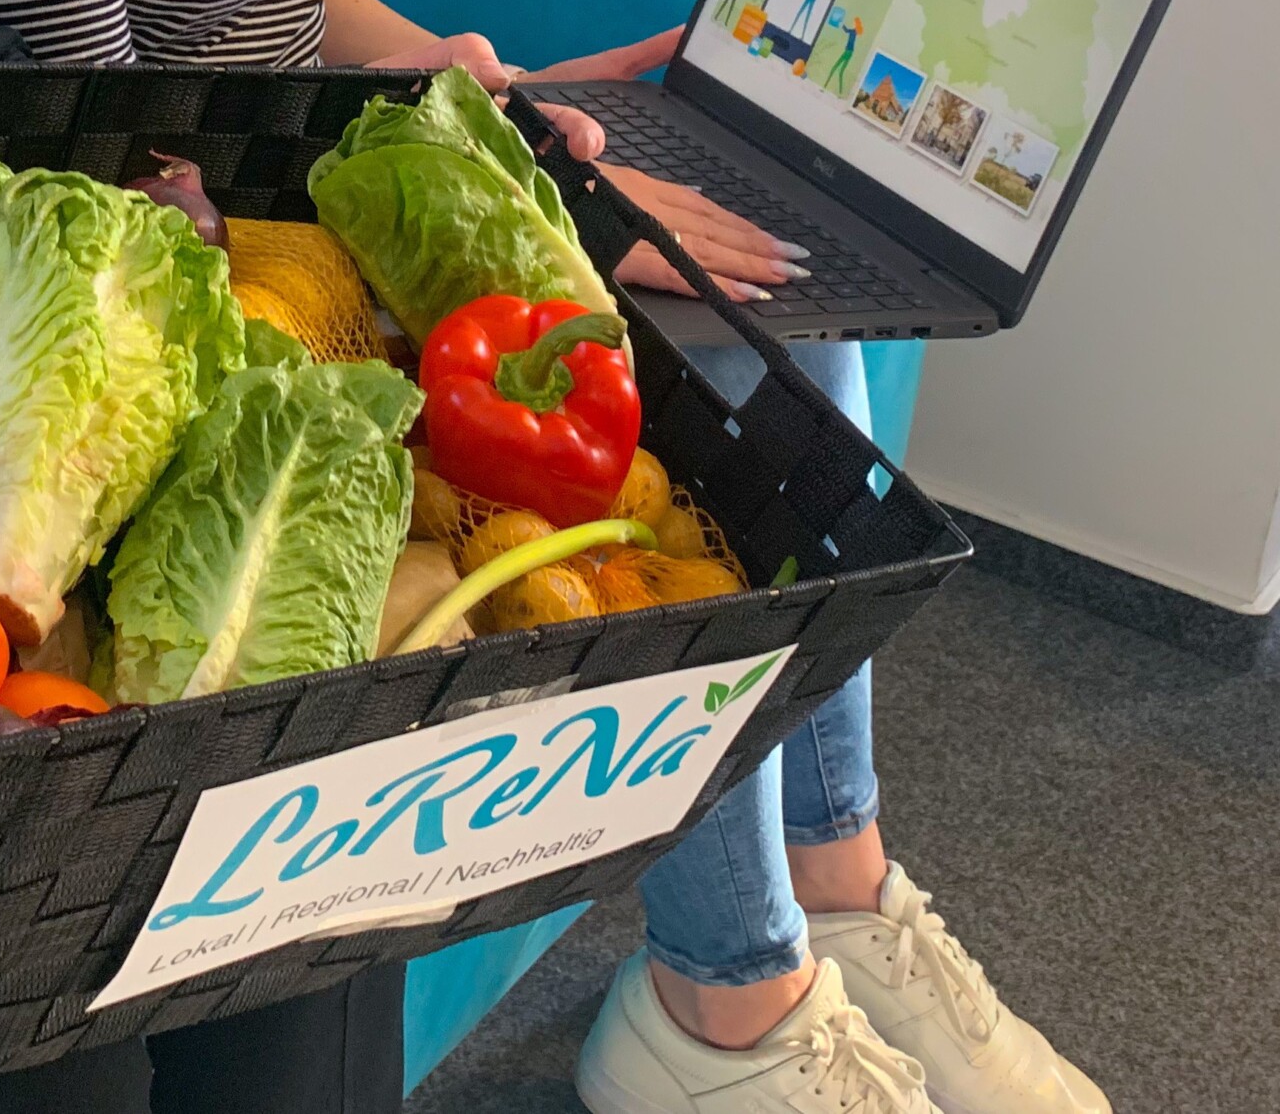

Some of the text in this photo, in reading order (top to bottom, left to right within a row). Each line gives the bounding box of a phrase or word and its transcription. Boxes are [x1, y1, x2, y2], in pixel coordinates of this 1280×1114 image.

[148, 695, 712, 932] LoReNa
[148, 923, 248, 975] Lokal
[269, 871, 424, 930] Regional
[445, 826, 606, 886] Nachhaltig
